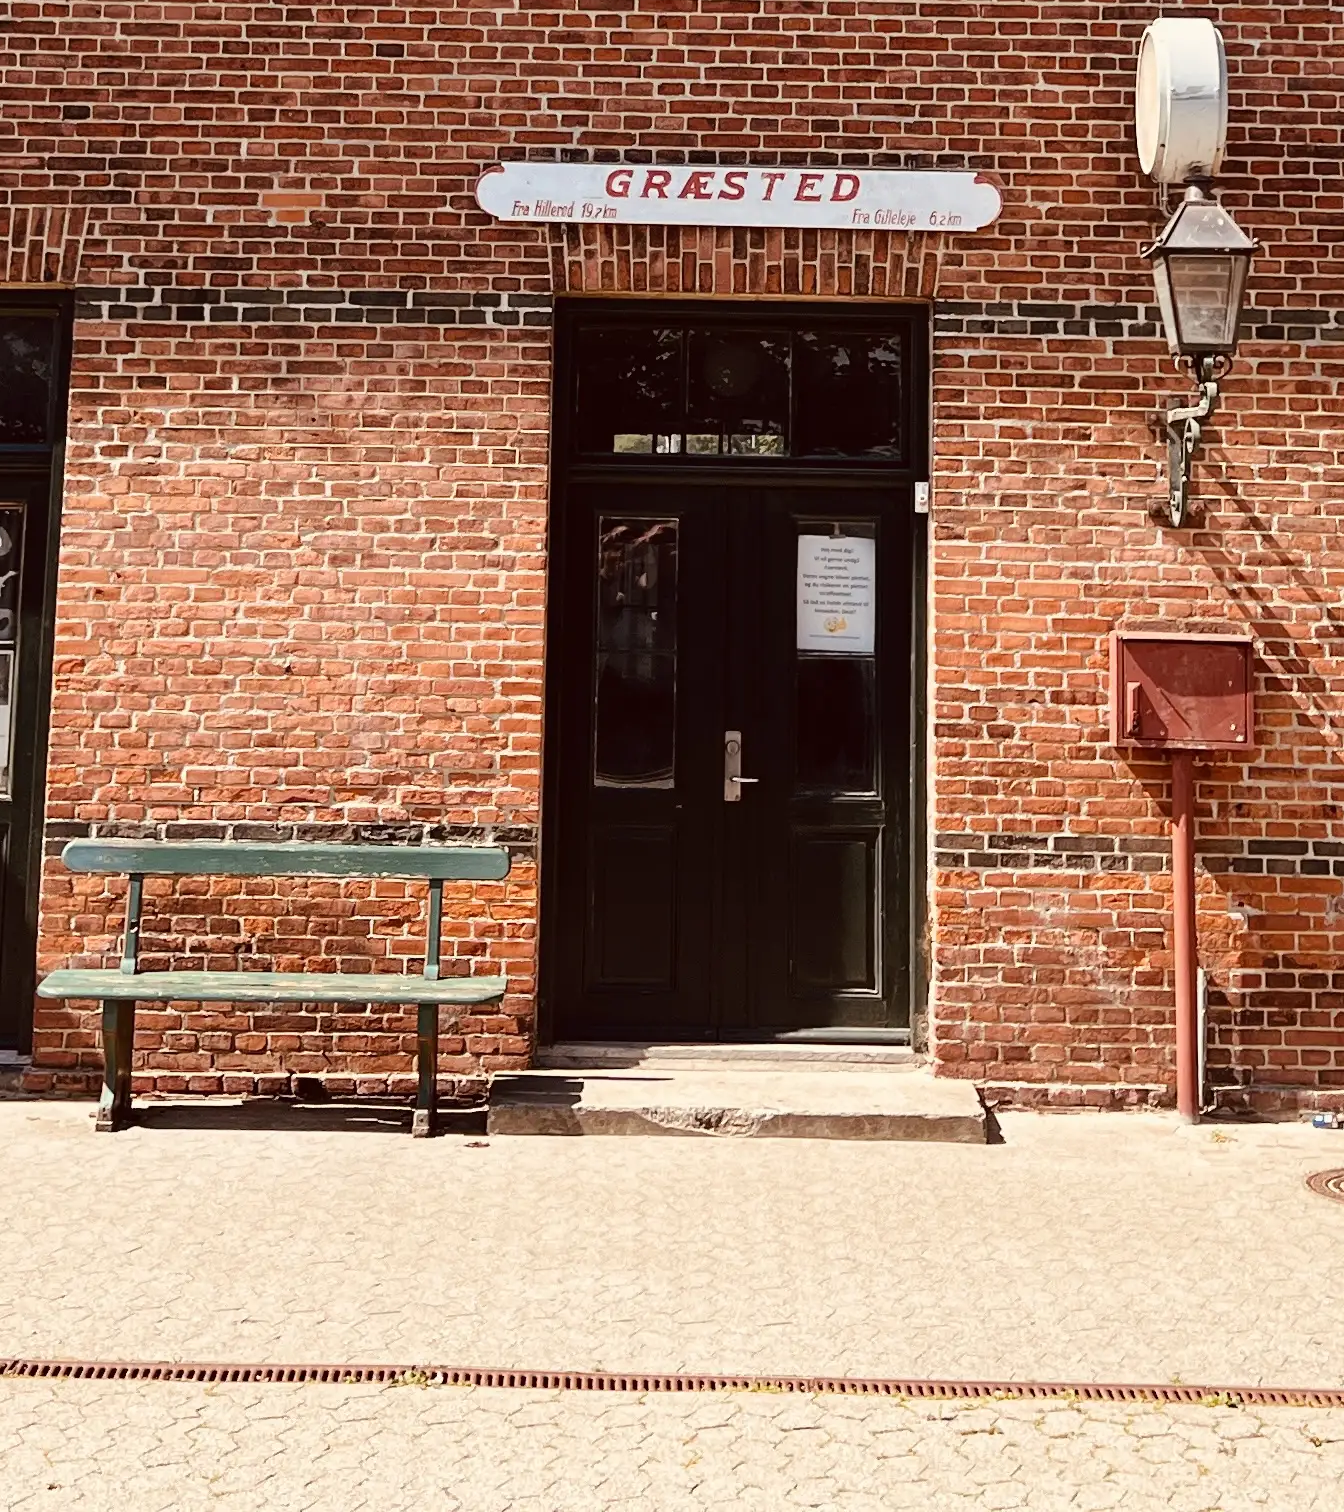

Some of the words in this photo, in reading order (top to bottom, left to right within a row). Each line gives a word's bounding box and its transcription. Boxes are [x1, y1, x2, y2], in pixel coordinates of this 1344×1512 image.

[604, 168, 862, 202] GRÆSTED
[510, 200, 530, 217] Fra
[852, 208, 870, 225] Fra
